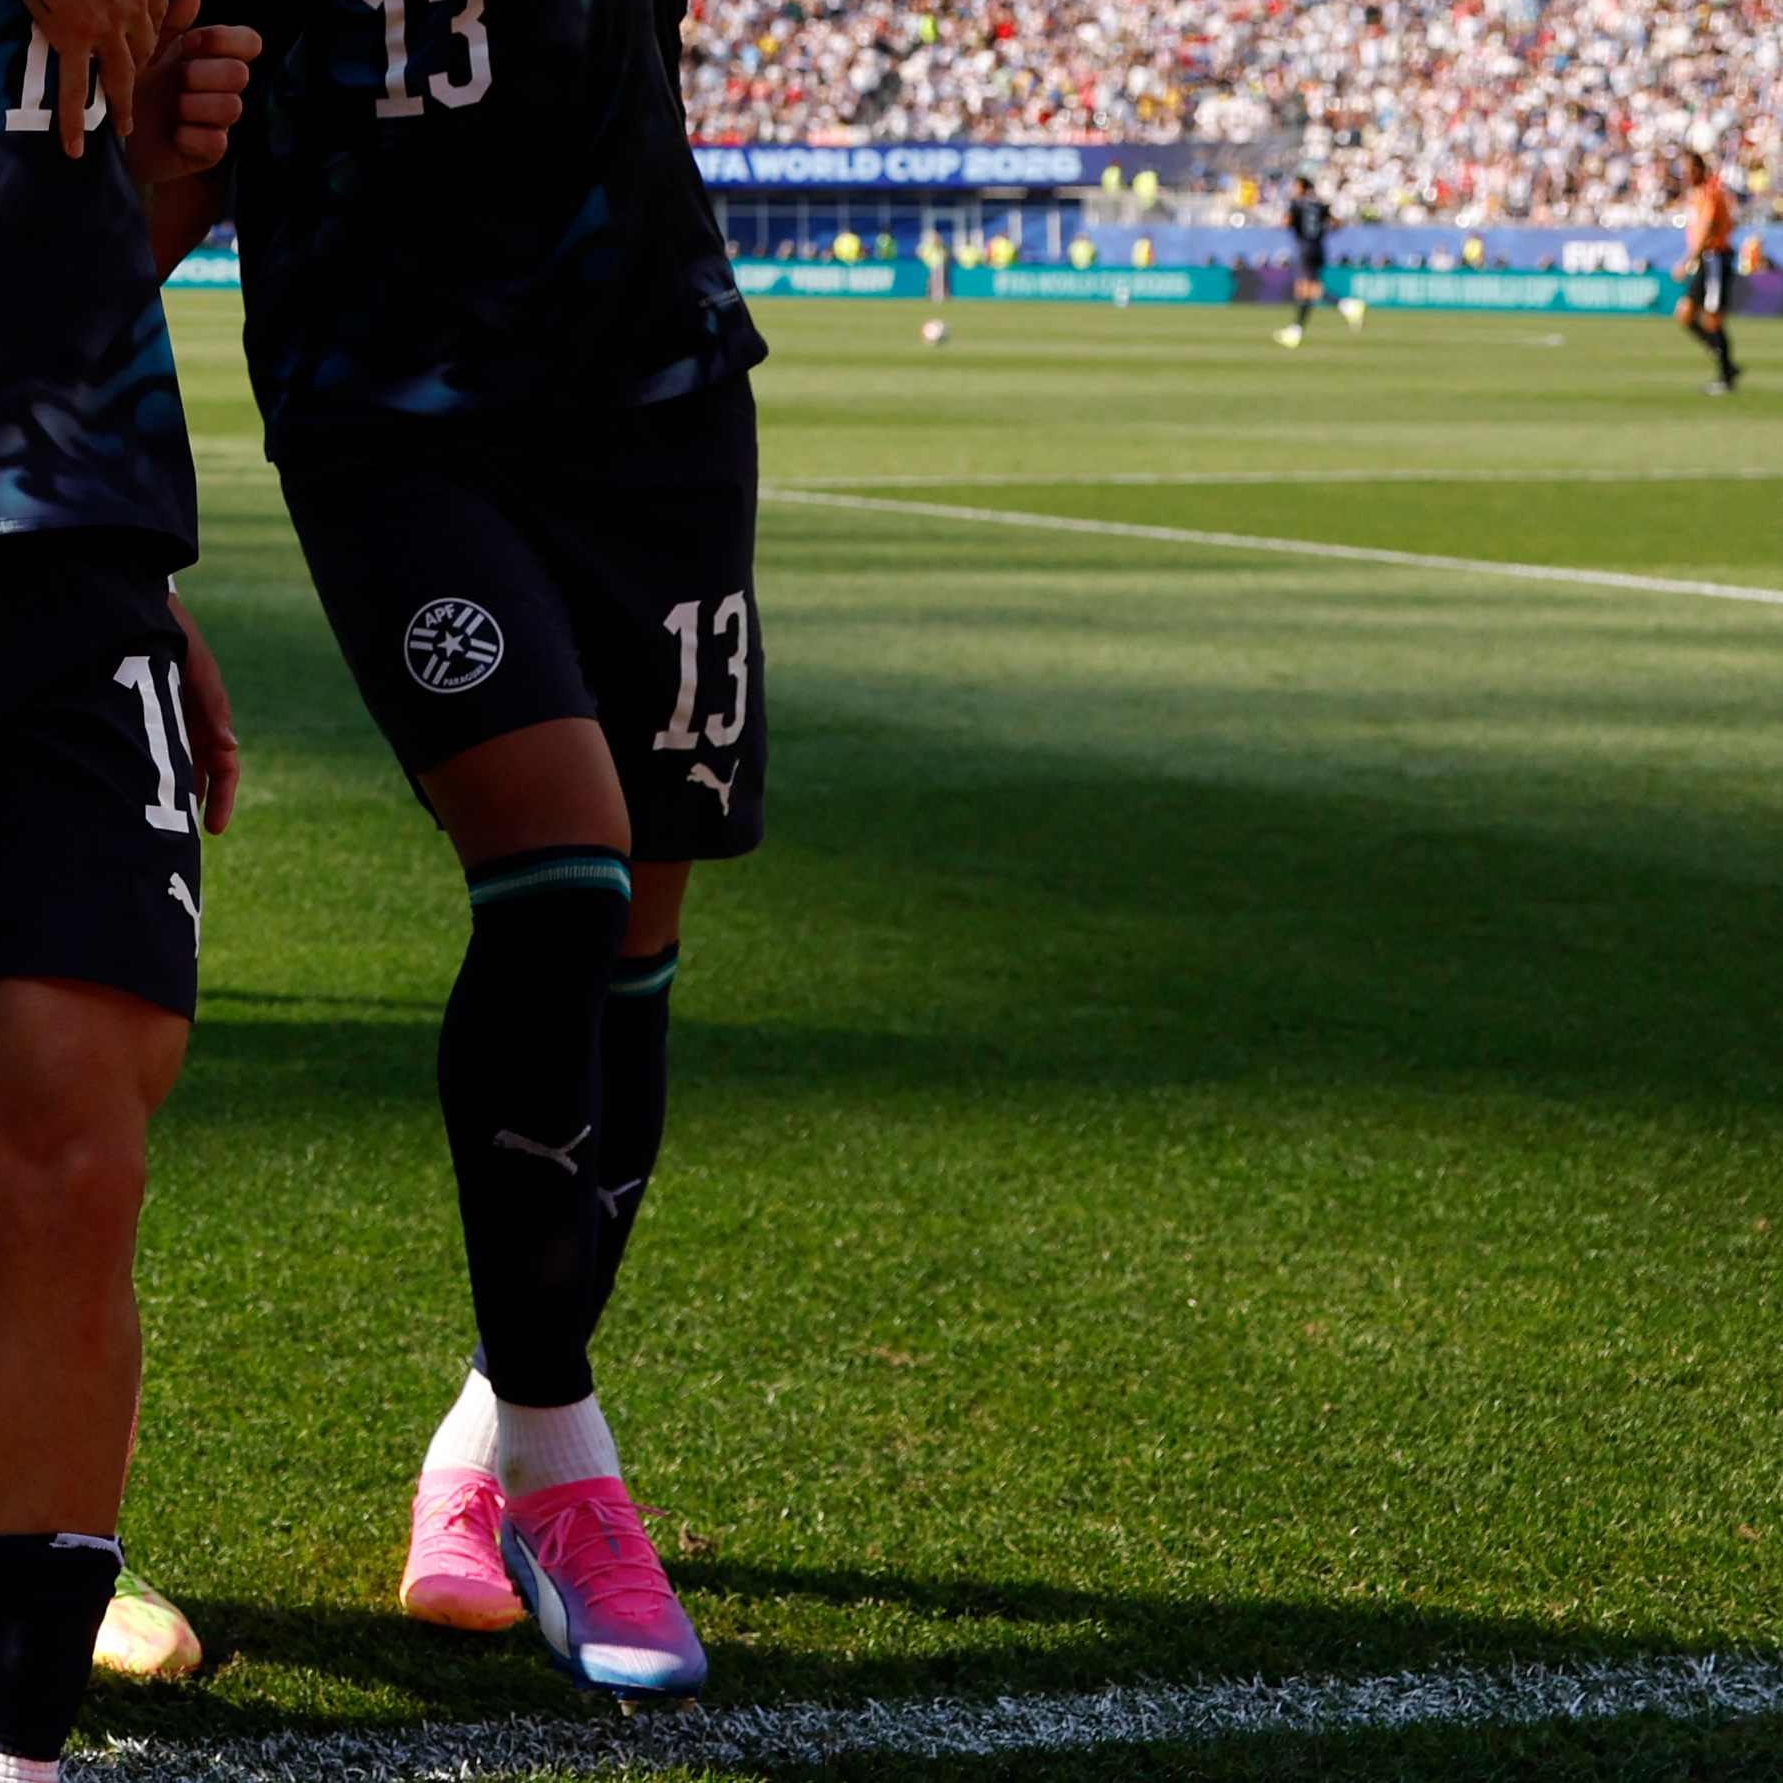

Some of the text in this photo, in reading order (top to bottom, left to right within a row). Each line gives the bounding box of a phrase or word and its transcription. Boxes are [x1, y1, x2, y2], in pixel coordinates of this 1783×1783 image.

[751, 146, 883, 185] WORLD
[883, 146, 962, 185] CUP
[962, 146, 1083, 185] 2026
[424, 603, 455, 629] APF
[652, 589, 749, 752] 13
[113, 655, 202, 843] 1
